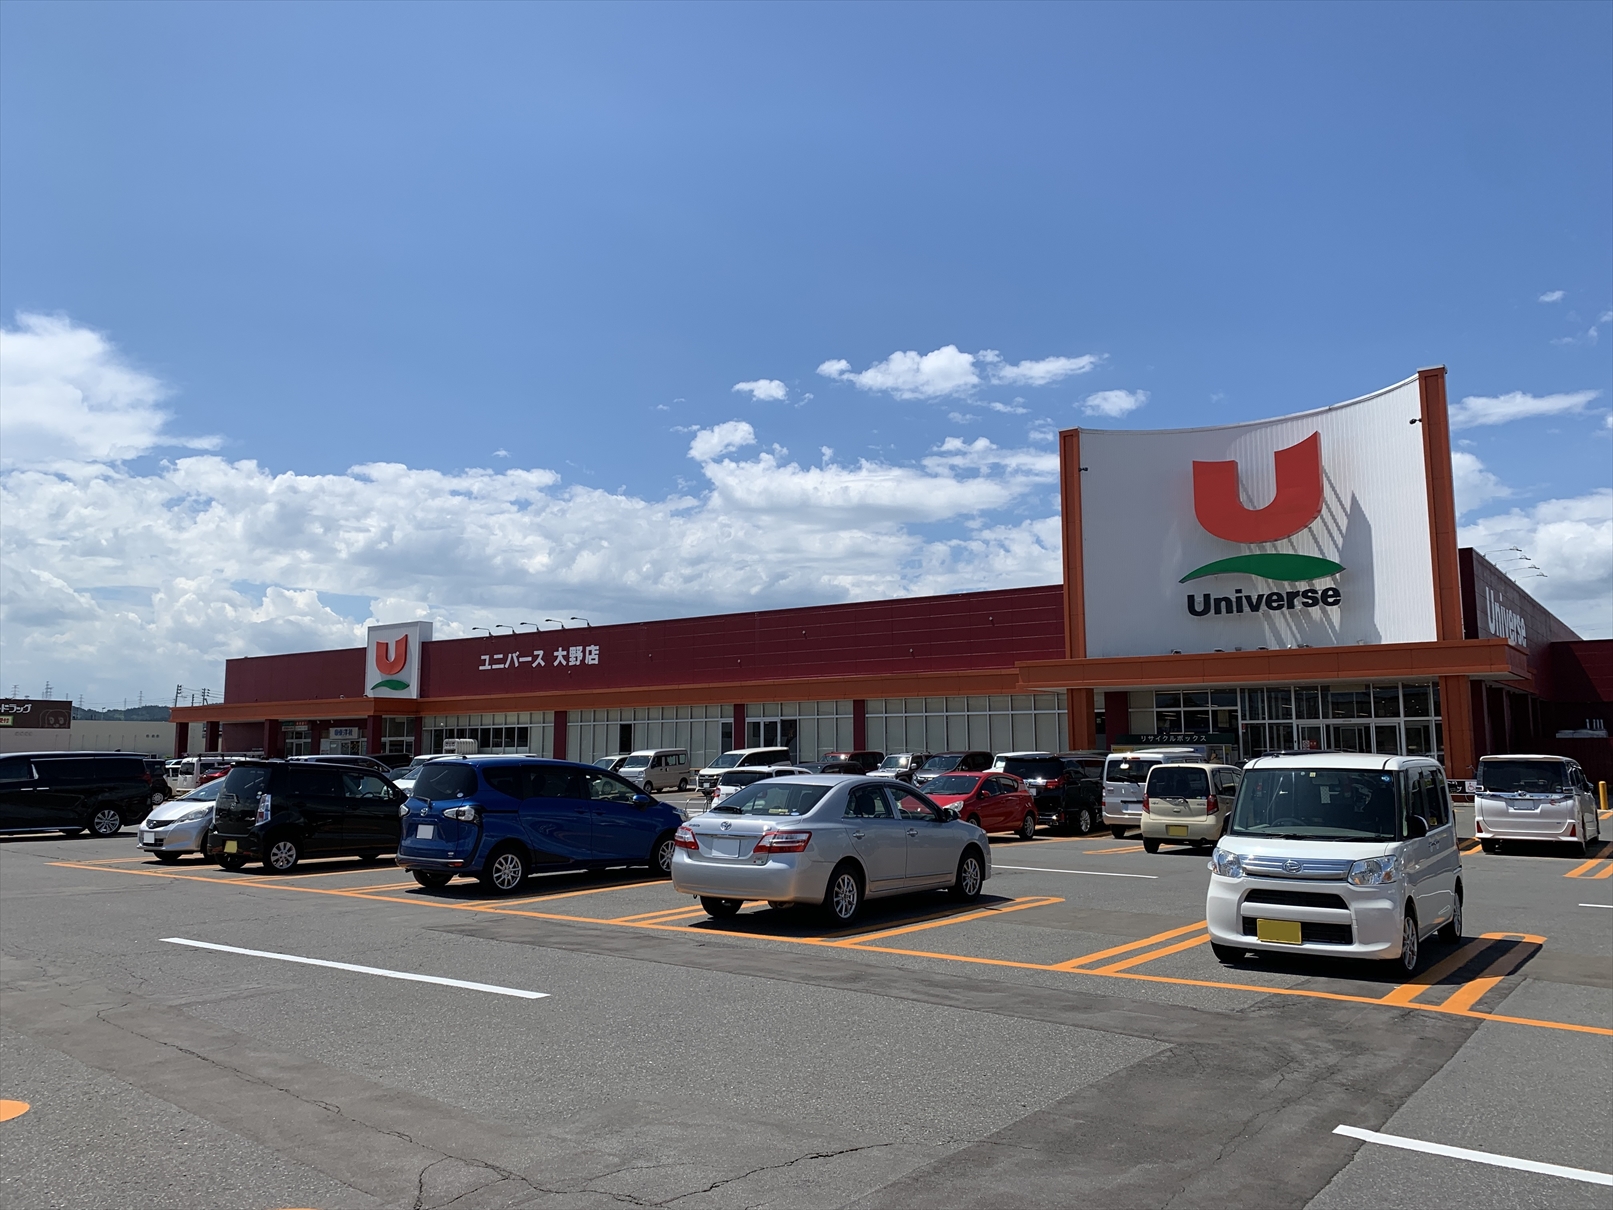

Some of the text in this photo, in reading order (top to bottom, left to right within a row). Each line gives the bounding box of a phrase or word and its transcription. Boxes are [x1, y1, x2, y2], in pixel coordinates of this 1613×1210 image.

[1192, 430, 1324, 544] U
[1187, 586, 1341, 617] Universe
[1485, 586, 1526, 647] Universe
[375, 634, 408, 675] U
[479, 645, 599, 670] ユニバース 大野店
[0, 703, 32, 714] ドラッグ
